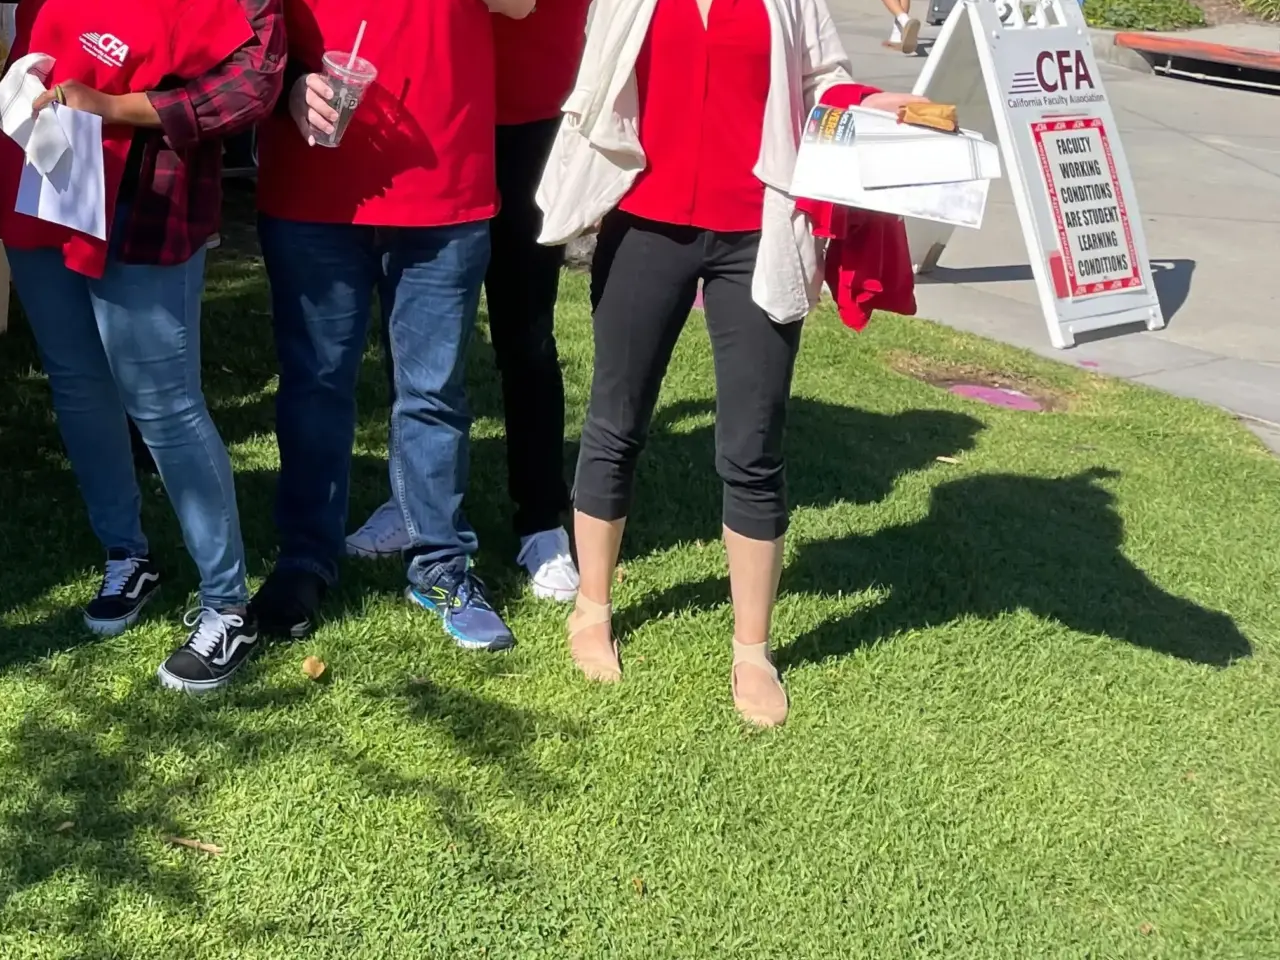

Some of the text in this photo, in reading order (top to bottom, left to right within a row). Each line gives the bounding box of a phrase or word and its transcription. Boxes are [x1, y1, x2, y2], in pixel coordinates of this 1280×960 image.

[98, 33, 130, 62] CFA
[1036, 50, 1096, 92] CFA
[1008, 94, 1105, 108] California Faculty Association
[1056, 136, 1092, 156] FACULTY
[1059, 159, 1102, 179] WORKING
[1060, 182, 1112, 204] CONDITIONS
[1065, 206, 1120, 228] ARE STUDENT
[1078, 230, 1118, 252] LEARNING
[1078, 254, 1128, 277] CONDITIONS
